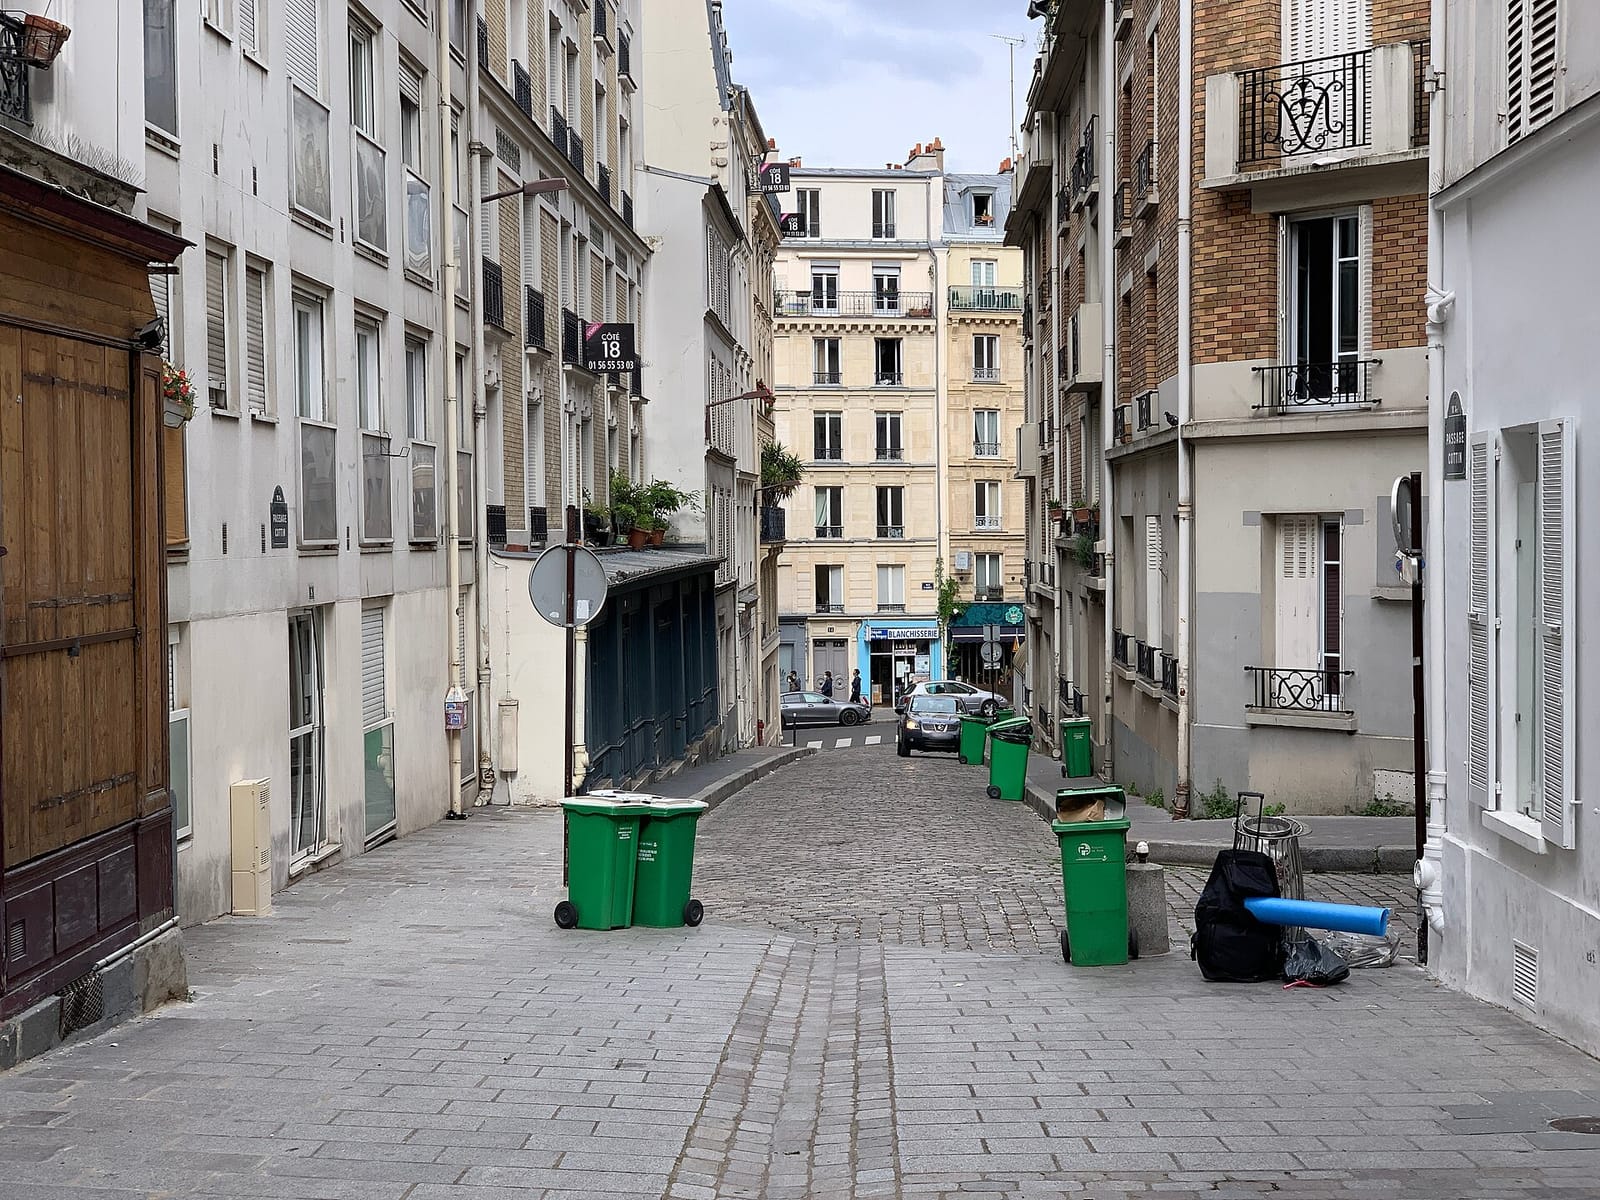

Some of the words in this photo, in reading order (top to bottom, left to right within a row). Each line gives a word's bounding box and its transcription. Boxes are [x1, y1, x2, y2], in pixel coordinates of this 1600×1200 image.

[770, 173, 781, 184] 18
[788, 222, 798, 231] 18
[601, 332, 620, 341] CÔTÉ
[602, 341, 621, 358] 18
[588, 361, 597, 370] 01
[598, 361, 607, 370] 56
[607, 361, 616, 370] 55
[616, 361, 625, 370] 53
[625, 361, 634, 370] 03
[1446, 431, 1465, 445] PASSAGE
[1447, 452, 1463, 465] COTTIN
[888, 630, 938, 638] BLANCHISSERIE
